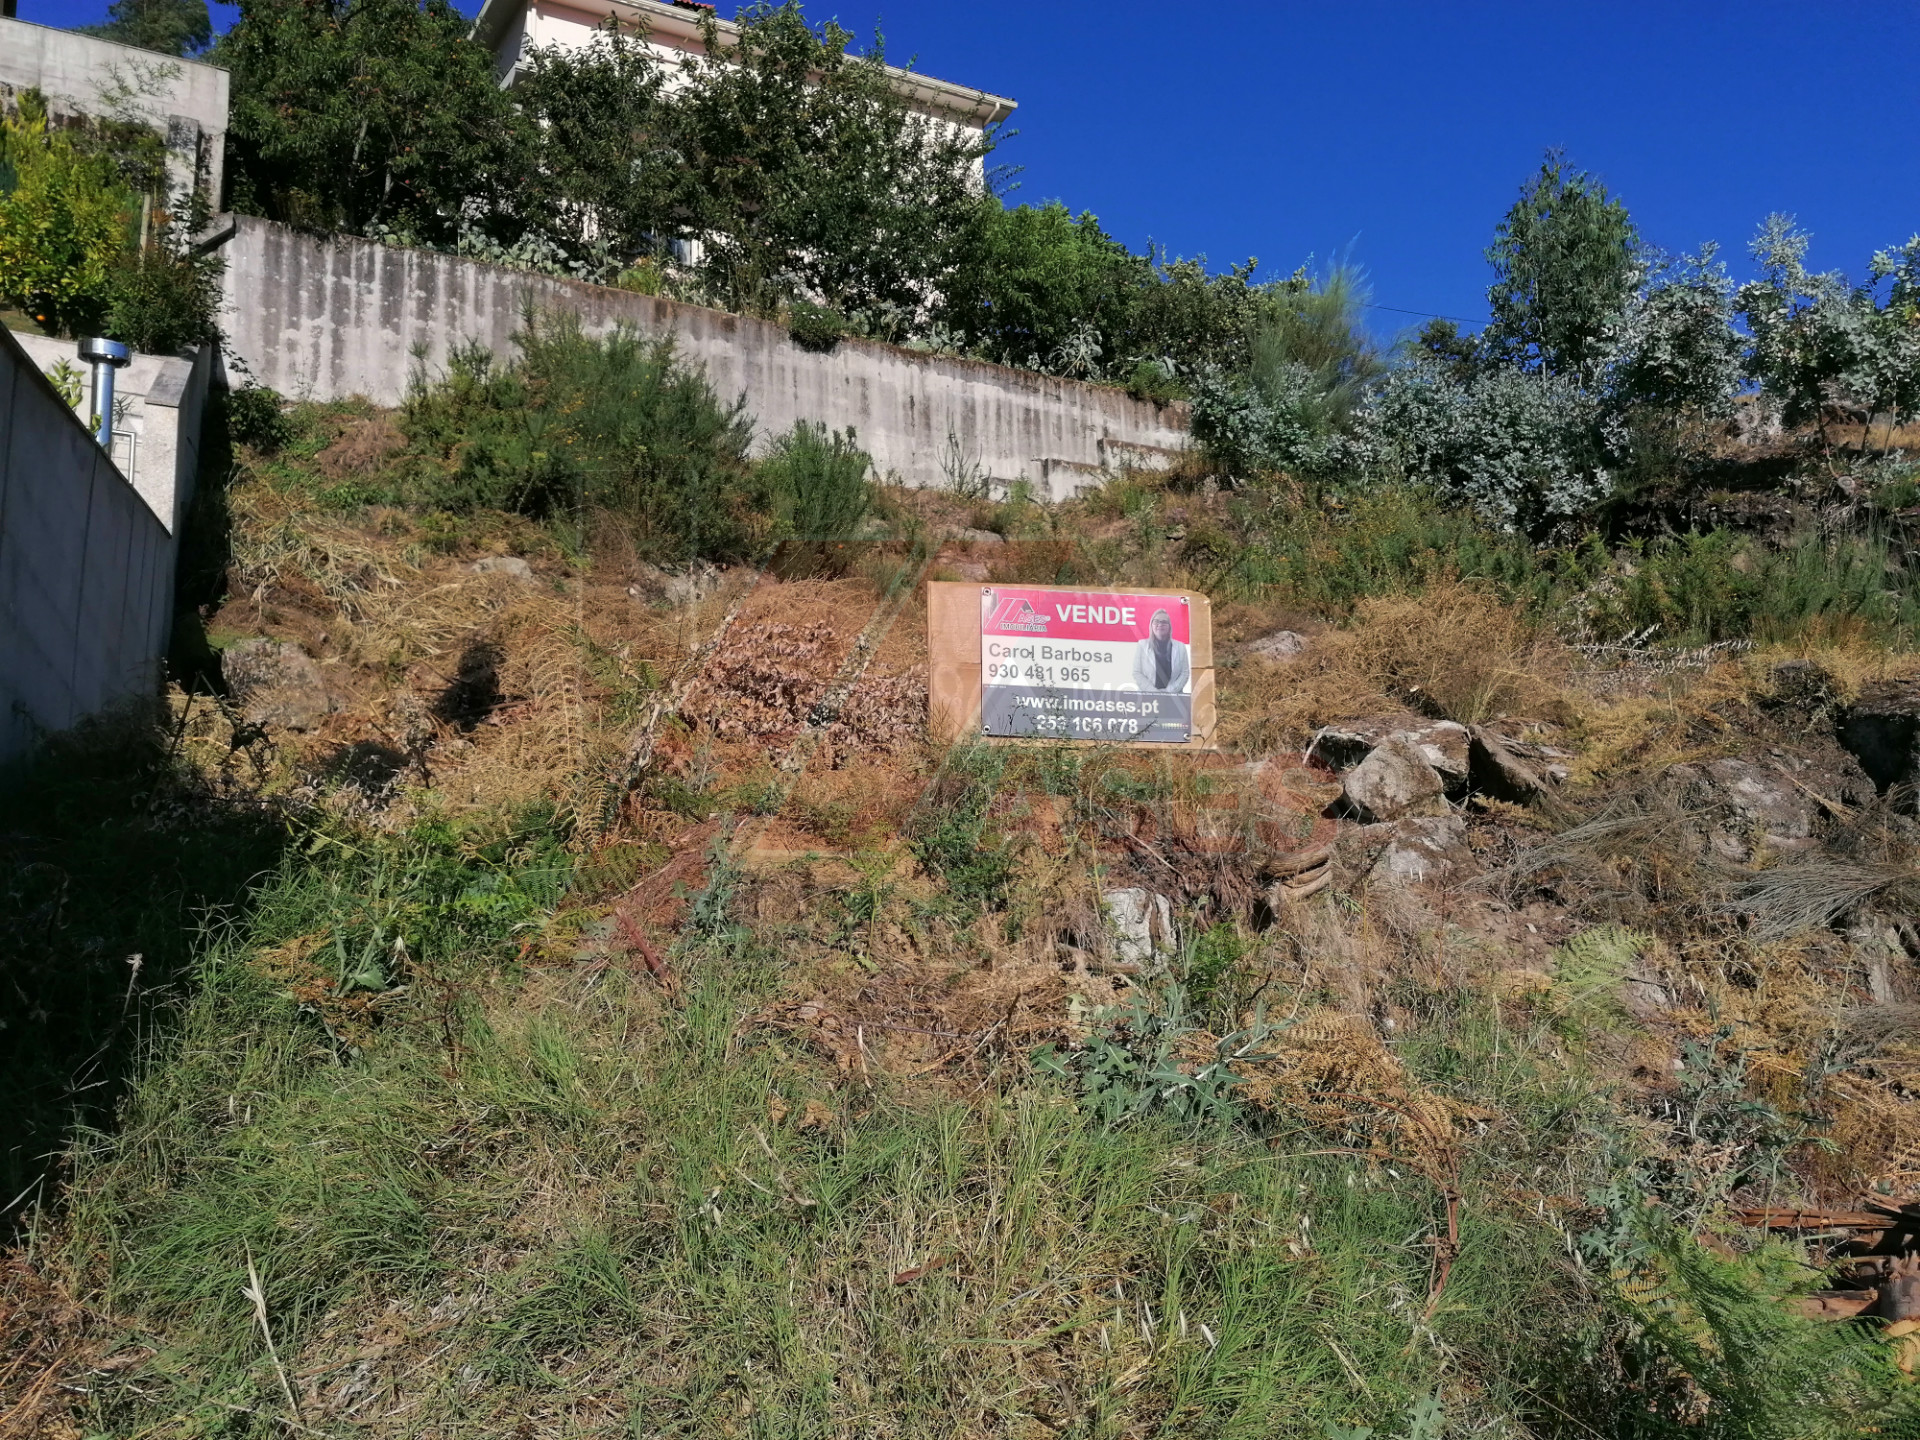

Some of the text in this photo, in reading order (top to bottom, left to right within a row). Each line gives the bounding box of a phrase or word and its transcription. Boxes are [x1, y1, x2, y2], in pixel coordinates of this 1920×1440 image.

[1055, 603, 1137, 626] VENDE
[989, 642, 1113, 663] Carol Barbosa
[988, 663, 1090, 683] 930 481 965
[1015, 695, 1159, 716] www.imoases.pt
